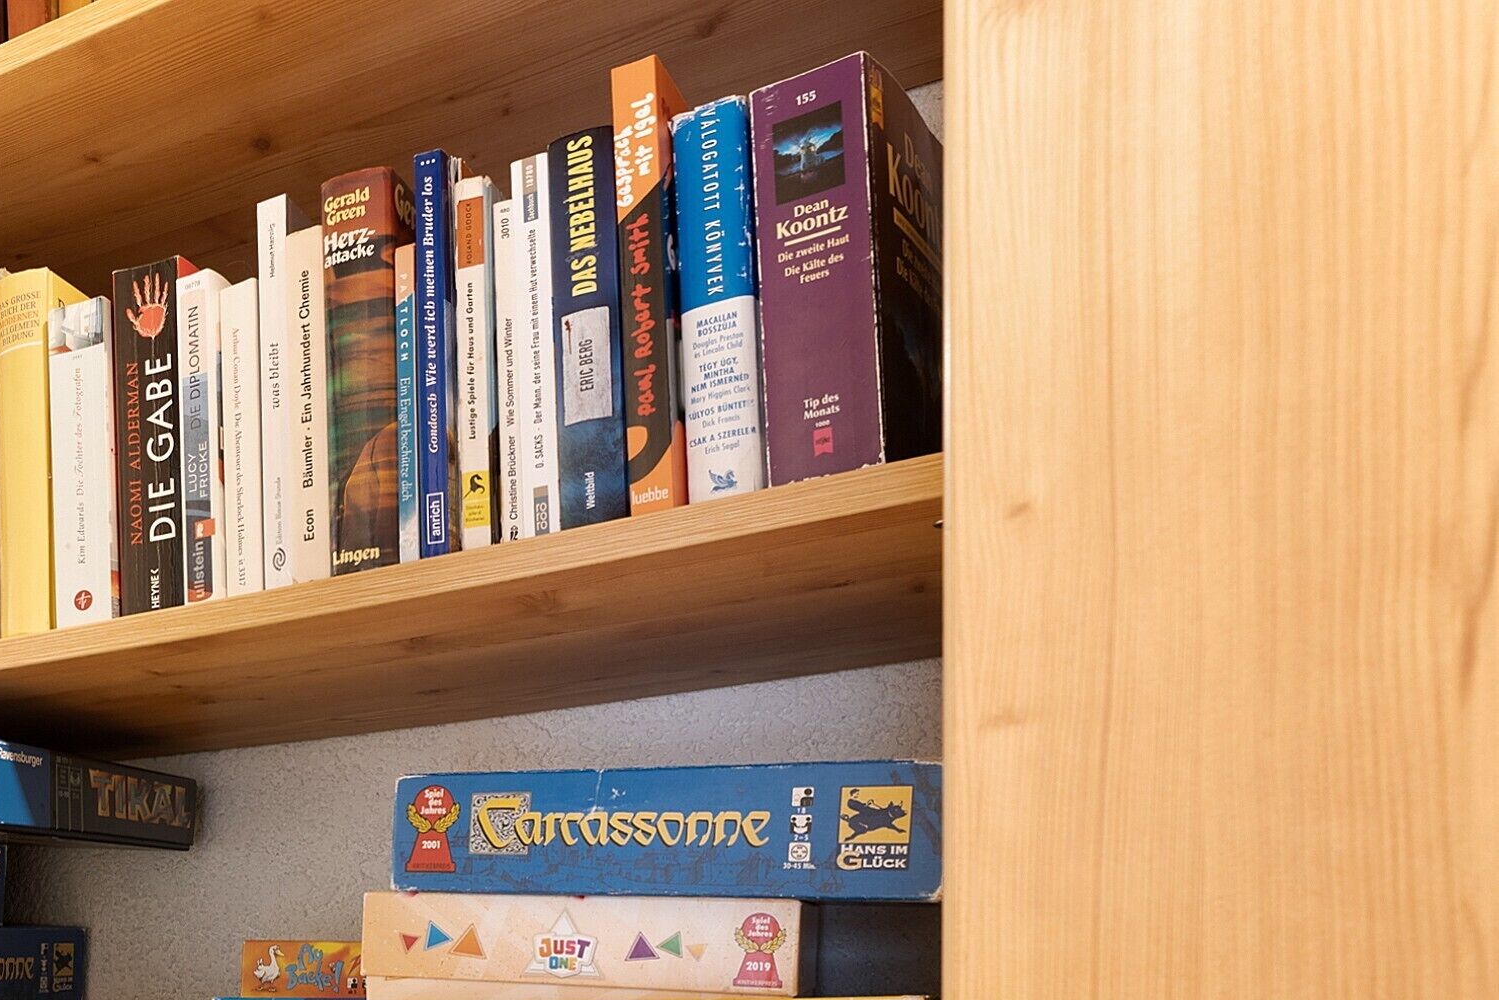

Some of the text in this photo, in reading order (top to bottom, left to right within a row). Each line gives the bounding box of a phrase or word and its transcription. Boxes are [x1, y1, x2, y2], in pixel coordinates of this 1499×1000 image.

[795, 90, 817, 105] 155
[324, 187, 370, 213] Gerald
[422, 177, 433, 197] los
[327, 205, 366, 226] Green
[567, 135, 597, 297] DAS NEBELHAUS
[700, 109, 724, 297] VÁLOGATOTT KÖNYVEK
[794, 199, 829, 217] Dean
[422, 200, 435, 247] Bruder
[501, 218, 510, 239] 3010
[776, 206, 848, 239] Koontz
[324, 228, 376, 254] Herz-
[324, 242, 375, 269] attacke
[778, 234, 849, 263] Die zweite Haut
[424, 250, 435, 298] meinen
[785, 254, 844, 277] Die Kälte des
[800, 269, 829, 284] Feuers
[424, 300, 436, 320] ich
[697, 311, 738, 328] MACALLAN
[425, 322, 438, 359] werd
[187, 305, 201, 430] DIE DIPLOMATIN
[269, 342, 281, 409] was bleibt
[425, 362, 438, 387] Wie
[579, 339, 594, 392] ERIC BERG
[299, 270, 315, 542] Econ Bäumler Ein Jahrhundert Chemie
[504, 317, 518, 520] Christine Brückner Wie Sommer und Winter
[804, 404, 840, 420] Monats
[127, 361, 143, 546] NAOMI ALDERMAN
[144, 353, 177, 542] DIE GABE
[188, 453, 198, 493] LUCY
[197, 441, 208, 498] FRICKE
[585, 472, 595, 509] Weltbild
[632, 486, 669, 507] luebbe
[429, 500, 441, 536] anrich
[332, 546, 380, 566] Lingen
[88, 768, 191, 829] TIKAL
[476, 791, 771, 850] Carcassonne
[538, 938, 591, 959] JUST
[549, 955, 577, 973] ONE
[746, 960, 771, 972] 2019
